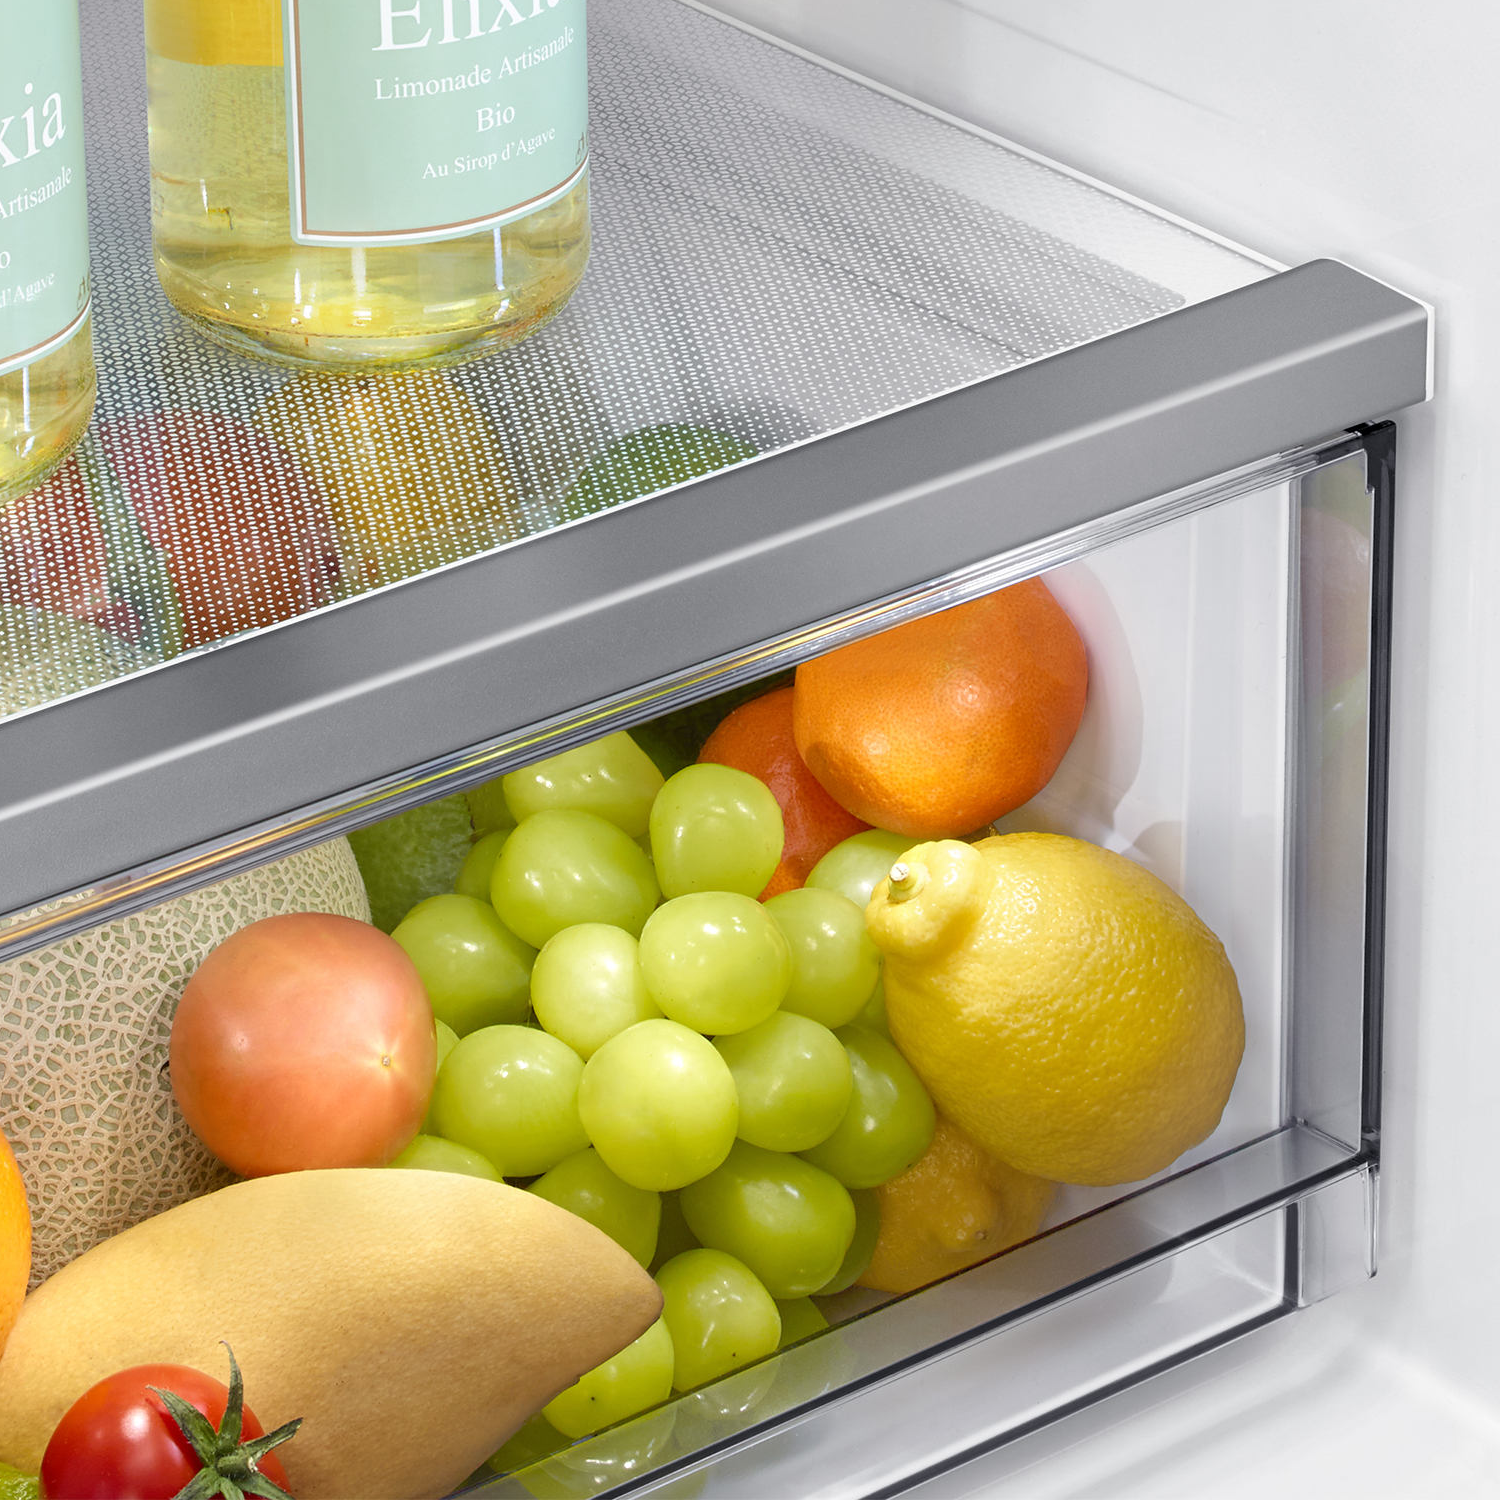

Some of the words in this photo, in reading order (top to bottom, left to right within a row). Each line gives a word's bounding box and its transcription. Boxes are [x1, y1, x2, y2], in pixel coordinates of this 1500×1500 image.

[373, 64, 493, 101] Limonade
[497, 24, 575, 81] Artisanale
[475, 101, 517, 134] Bio
[421, 161, 450, 181] Au
[453, 151, 499, 175] Sirop
